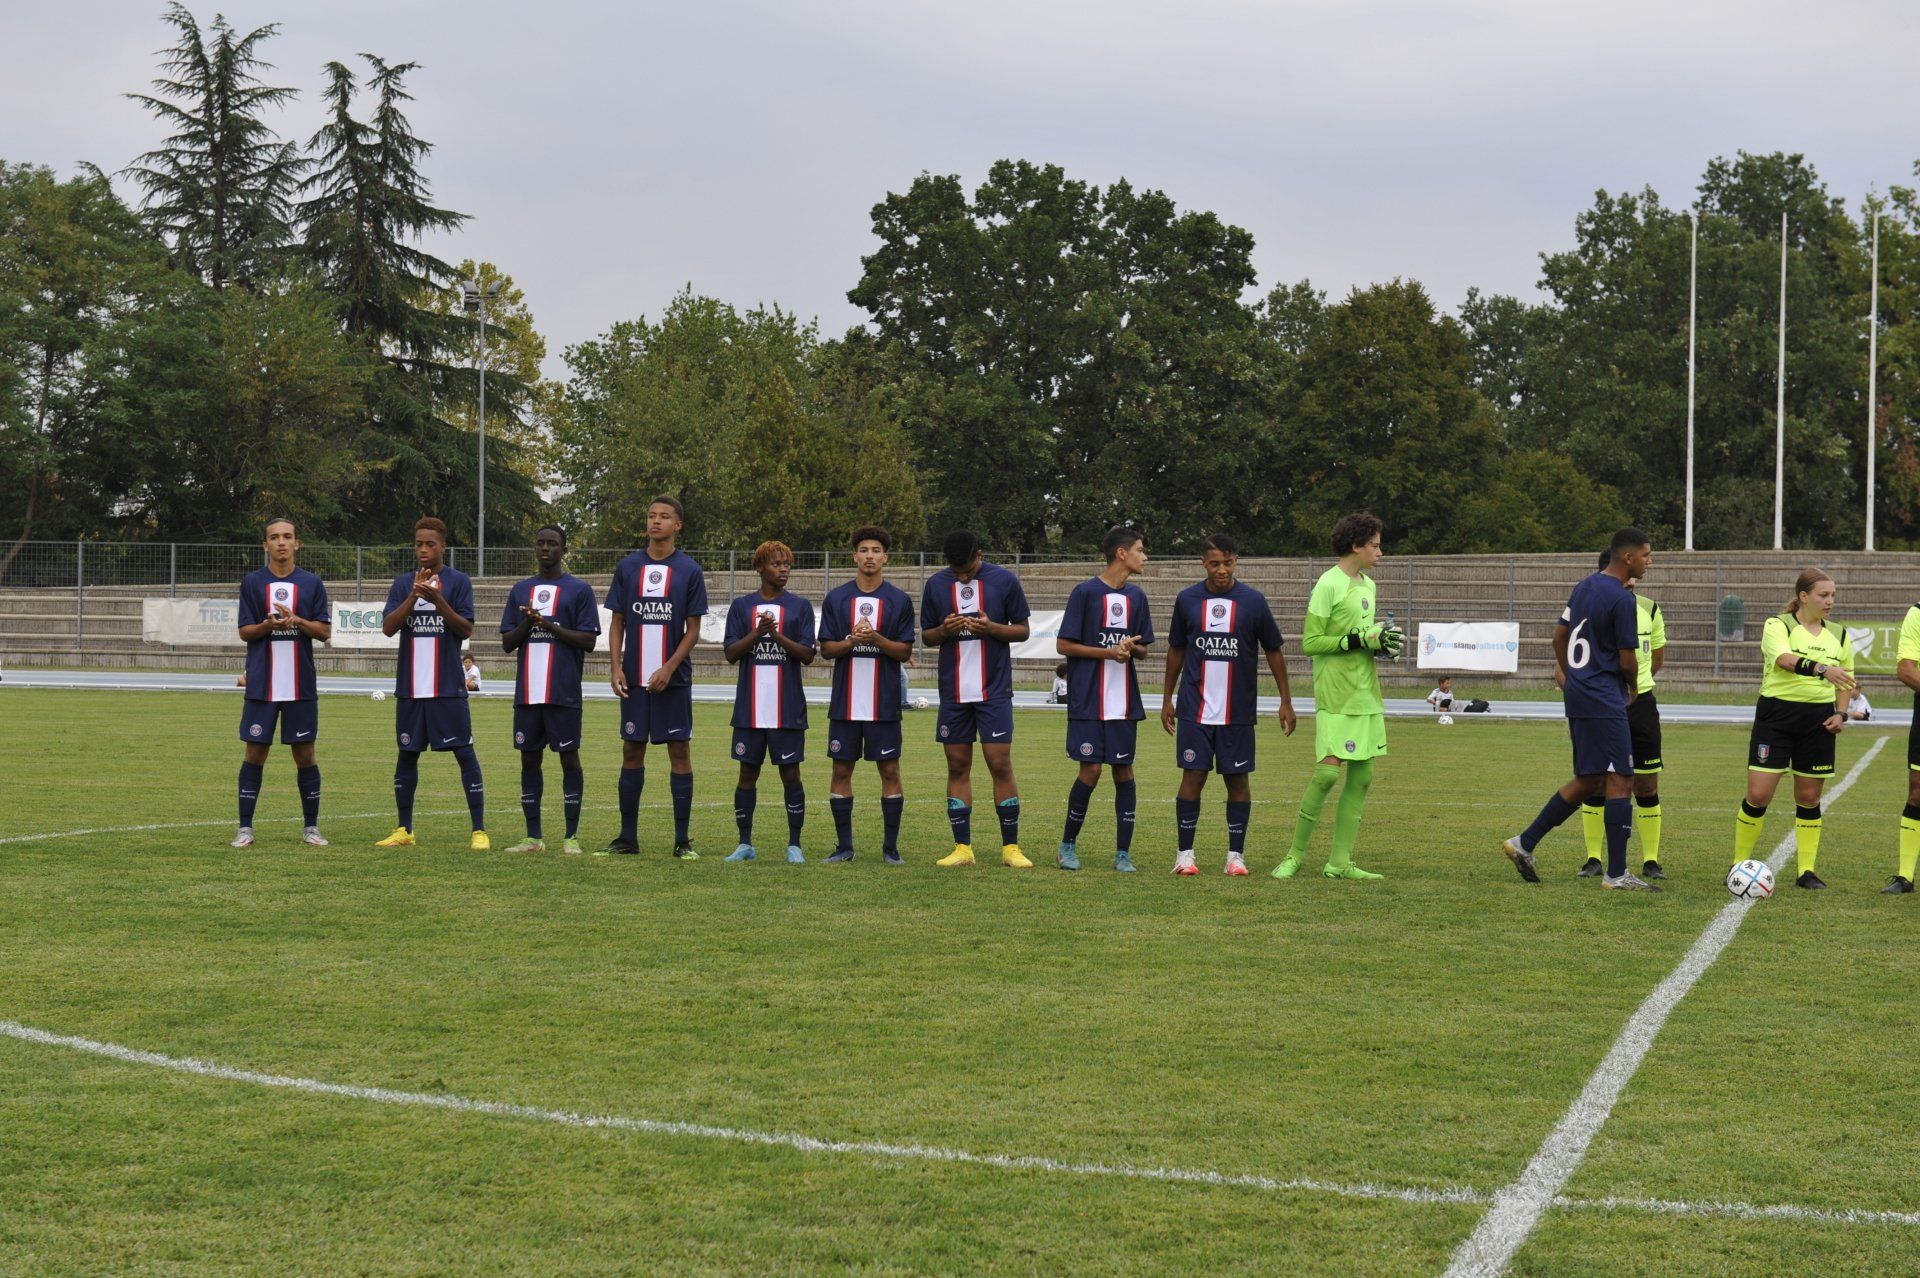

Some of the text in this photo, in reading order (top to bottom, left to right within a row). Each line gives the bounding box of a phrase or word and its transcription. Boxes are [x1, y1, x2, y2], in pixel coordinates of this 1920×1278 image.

[632, 602, 673, 615] QATAR
[407, 615, 445, 628] QATAR
[642, 613, 672, 621] AIRWAYS
[412, 626, 445, 634] AIRWAYS
[1195, 636, 1238, 650] QATAR
[1567, 618, 1590, 668] 6
[755, 652, 787, 660] AIRWAYS
[1205, 648, 1238, 657] AIRWAYS
